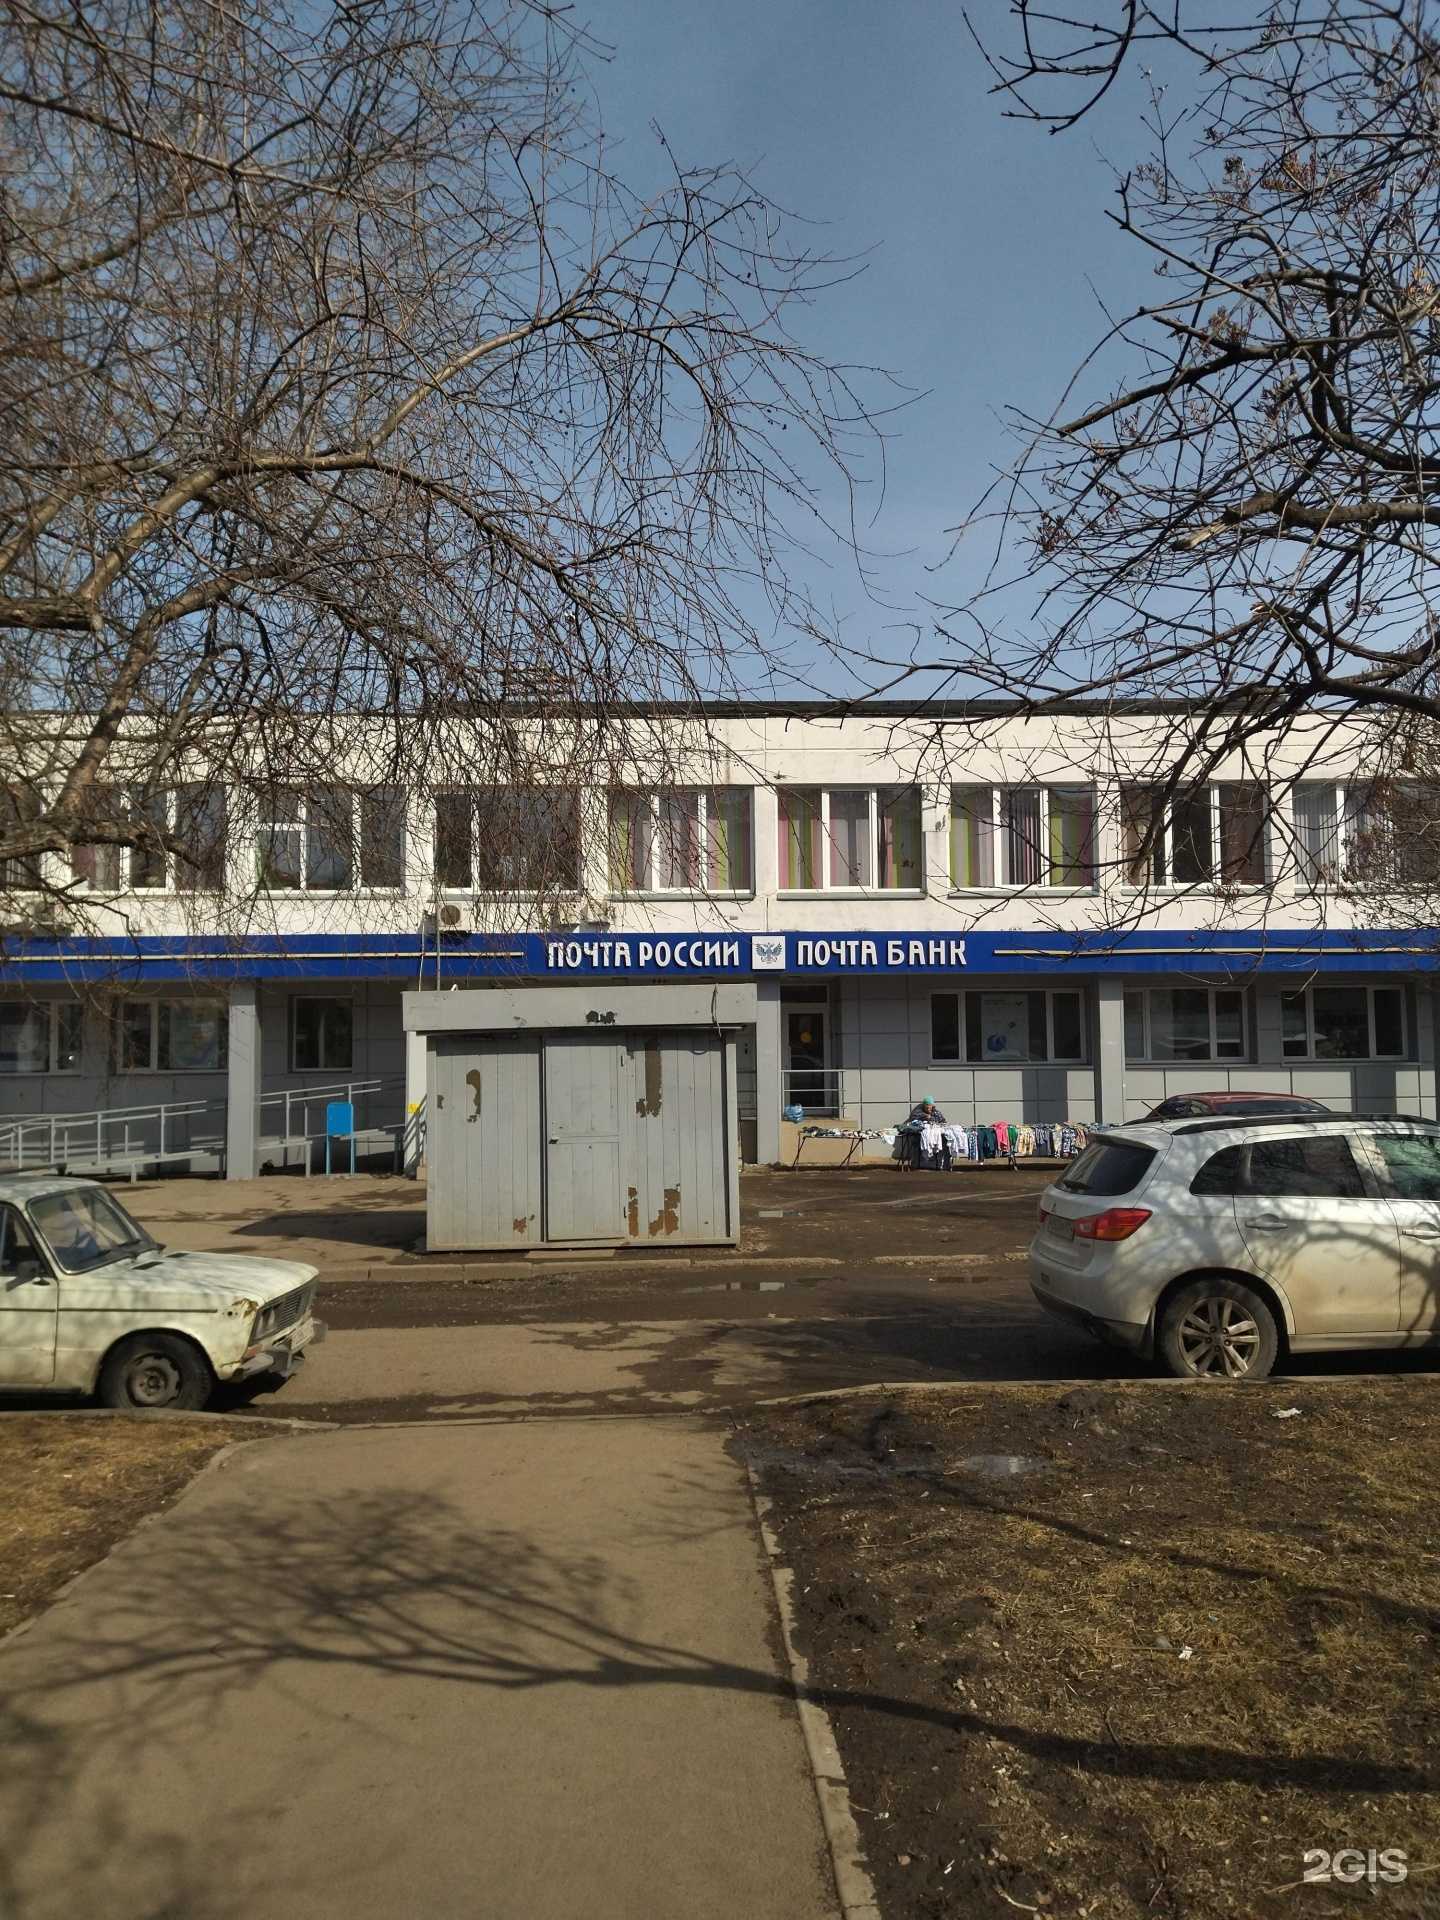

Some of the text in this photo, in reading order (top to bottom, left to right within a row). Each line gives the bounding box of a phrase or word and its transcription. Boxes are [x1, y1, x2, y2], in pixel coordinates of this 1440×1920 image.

[547, 940, 740, 968] ПОЧТА РОССИИ
[797, 939, 967, 966] ПОЧТА БАНК
